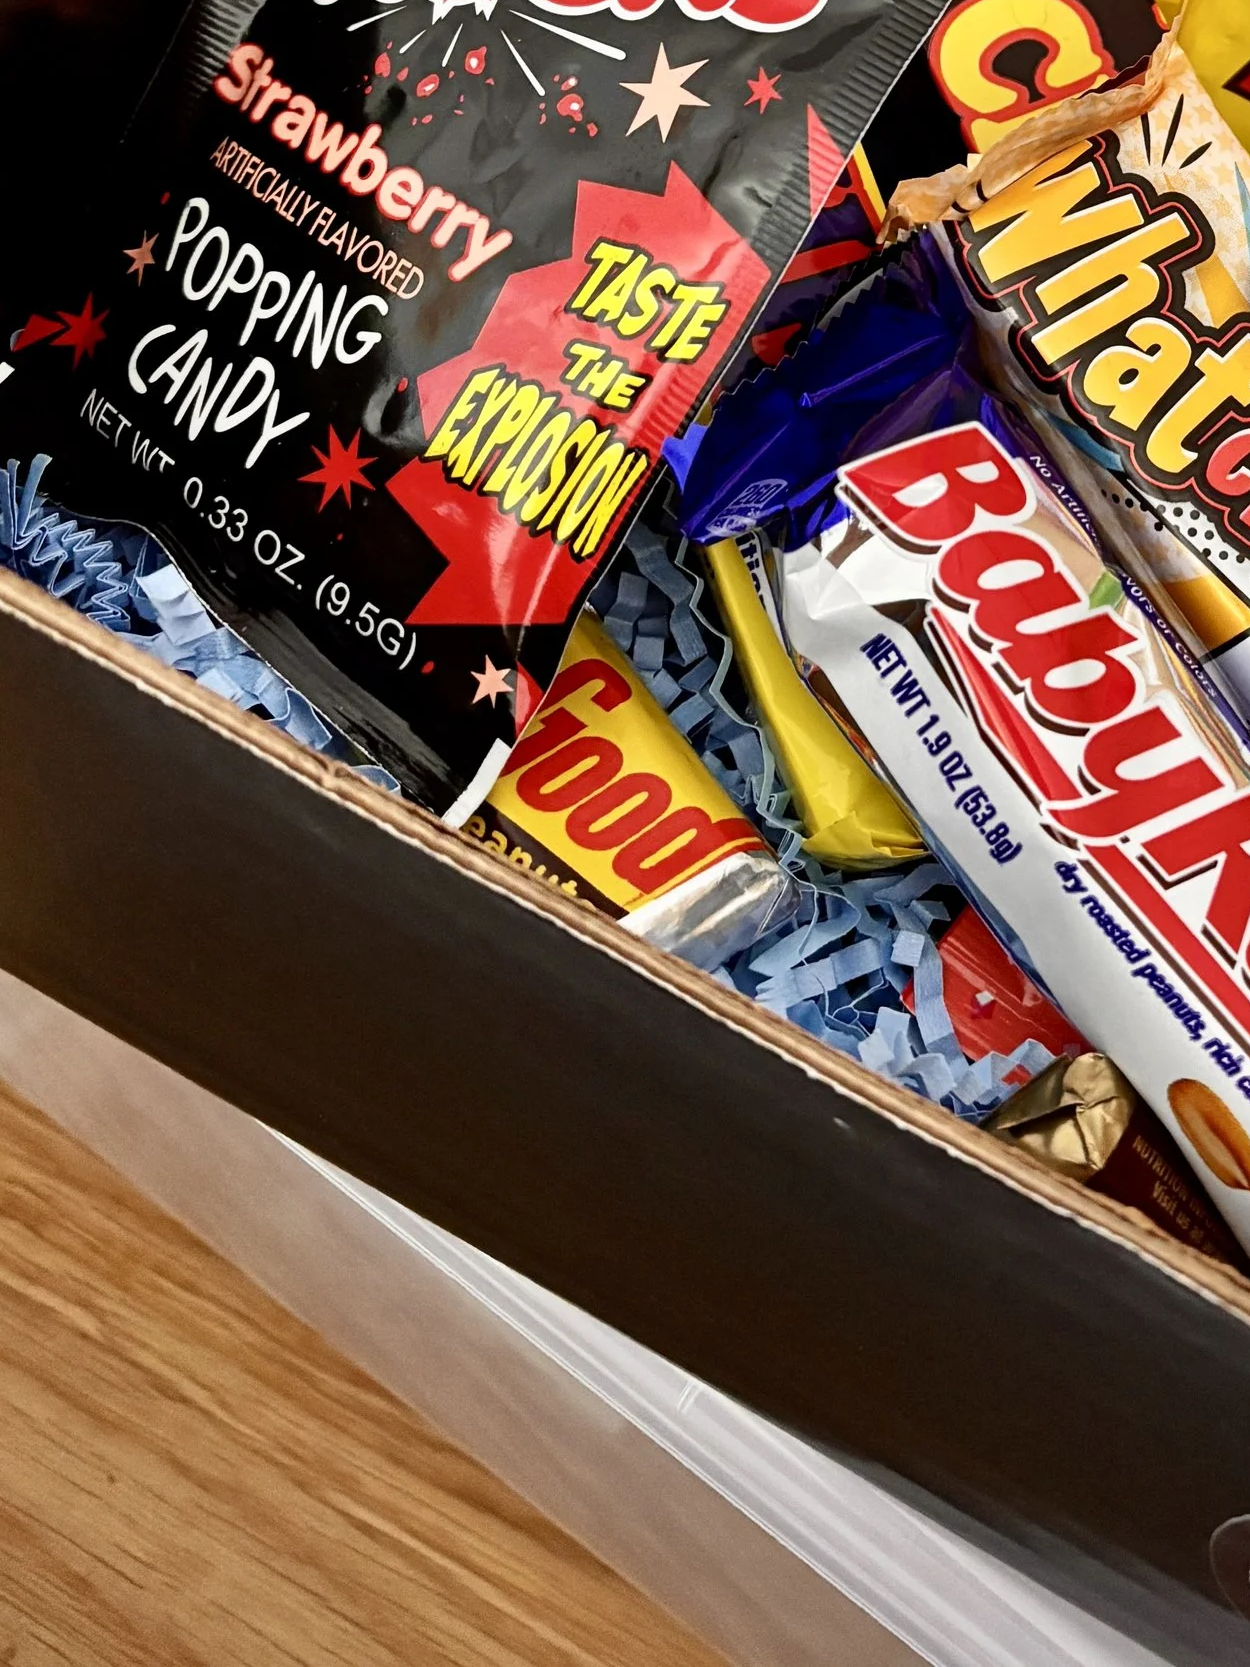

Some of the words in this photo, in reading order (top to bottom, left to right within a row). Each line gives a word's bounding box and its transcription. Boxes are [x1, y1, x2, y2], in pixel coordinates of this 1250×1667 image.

[210, 137, 319, 225] ARTIFICIALLY
[309, 206, 425, 300] FLAVORED
[213, 42, 514, 283] Strawberry
[165, 197, 389, 369] POPPING
[568, 239, 730, 364] TASTE
[127, 324, 311, 469] CANDY
[561, 341, 648, 409] THE
[80, 388, 132, 448] NET
[131, 431, 175, 473] WT
[183, 476, 249, 542] 0.33
[253, 529, 306, 591] OZ.
[315, 574, 417, 671] (9.5G)
[424, 366, 648, 563] EXPLOSION
[1029, 456, 1052, 477] No
[1175, 641, 1217, 698] Colors
[859, 633, 907, 679] NET
[889, 669, 931, 719] WT
[916, 714, 952, 757] 1.9
[938, 750, 974, 792] OZ
[954, 784, 1023, 866] (53.8g)
[1053, 860, 1088, 894] dry
[1079, 894, 1152, 964] roasted
[1130, 962, 1207, 1042] peanuts,
[1202, 1036, 1246, 1078] rich
